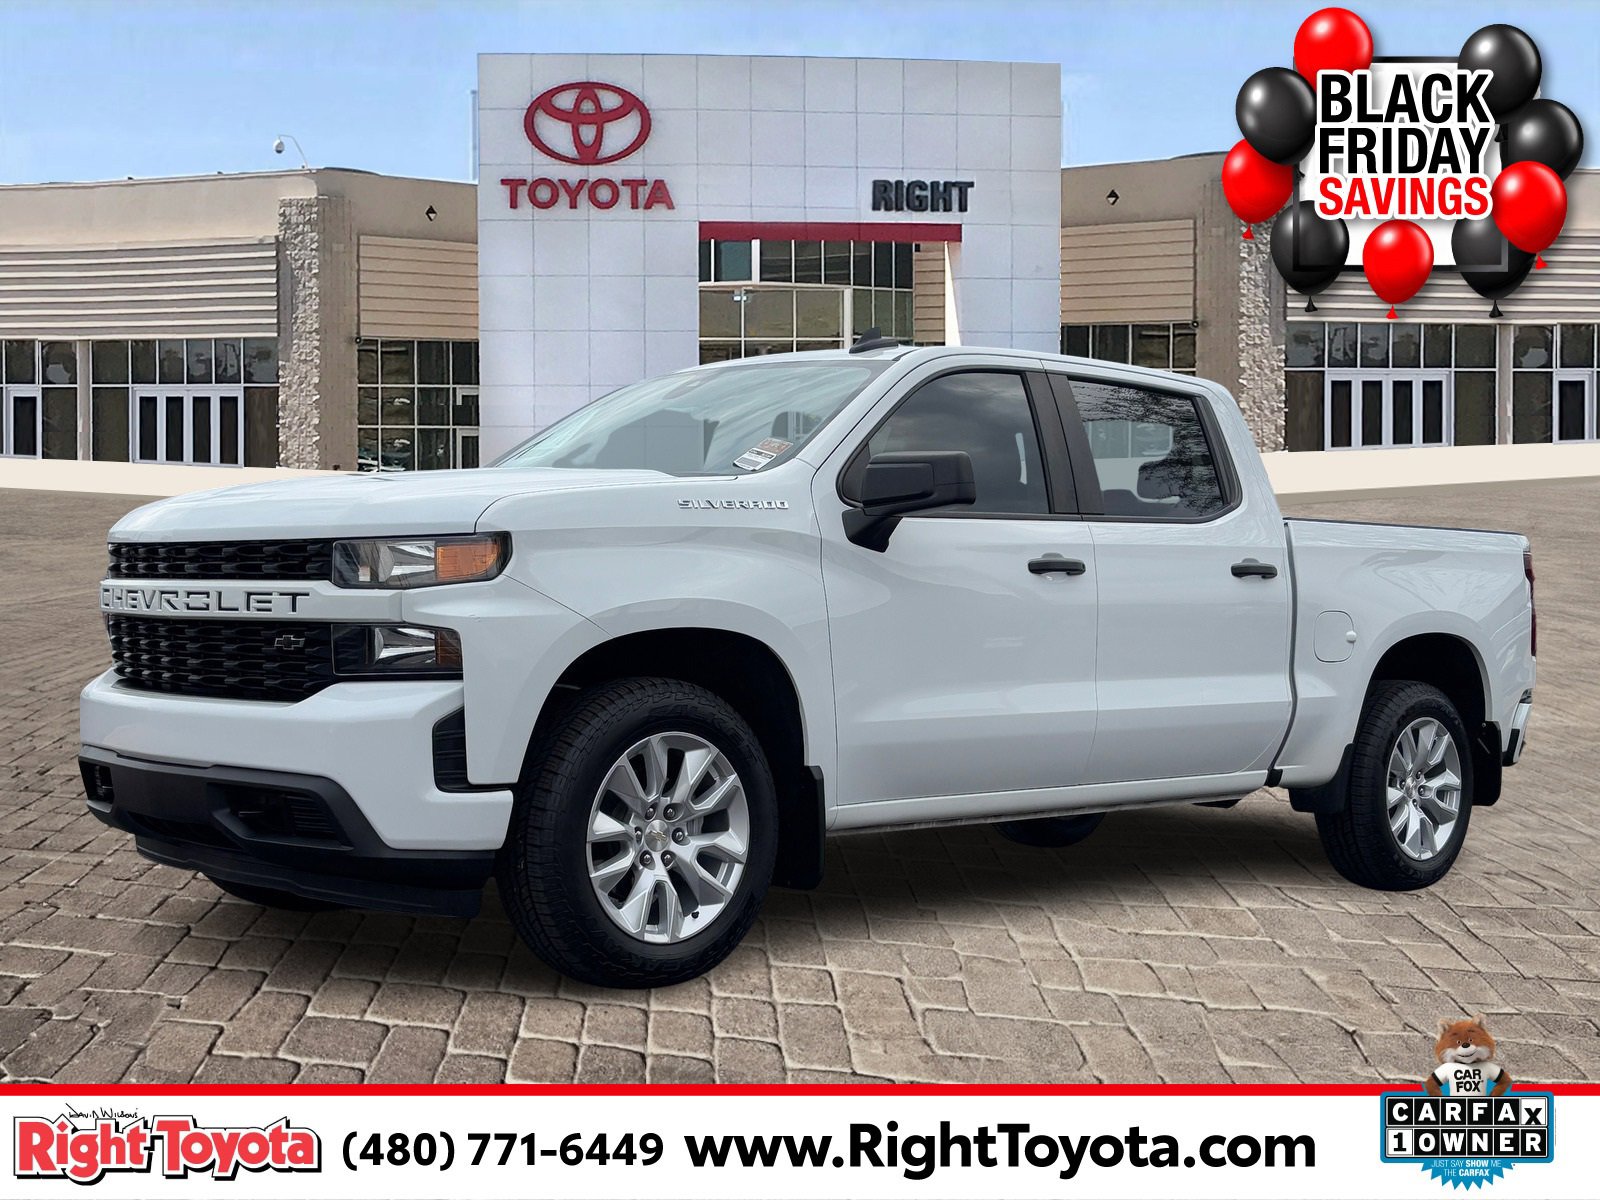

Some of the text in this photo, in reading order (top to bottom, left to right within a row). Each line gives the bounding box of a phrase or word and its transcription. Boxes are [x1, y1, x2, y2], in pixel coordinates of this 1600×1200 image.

[501, 178, 675, 210] TOYOTA
[871, 179, 974, 213] RIGHT
[677, 499, 789, 510] SILVERADO
[101, 587, 311, 614] CHEVROLET
